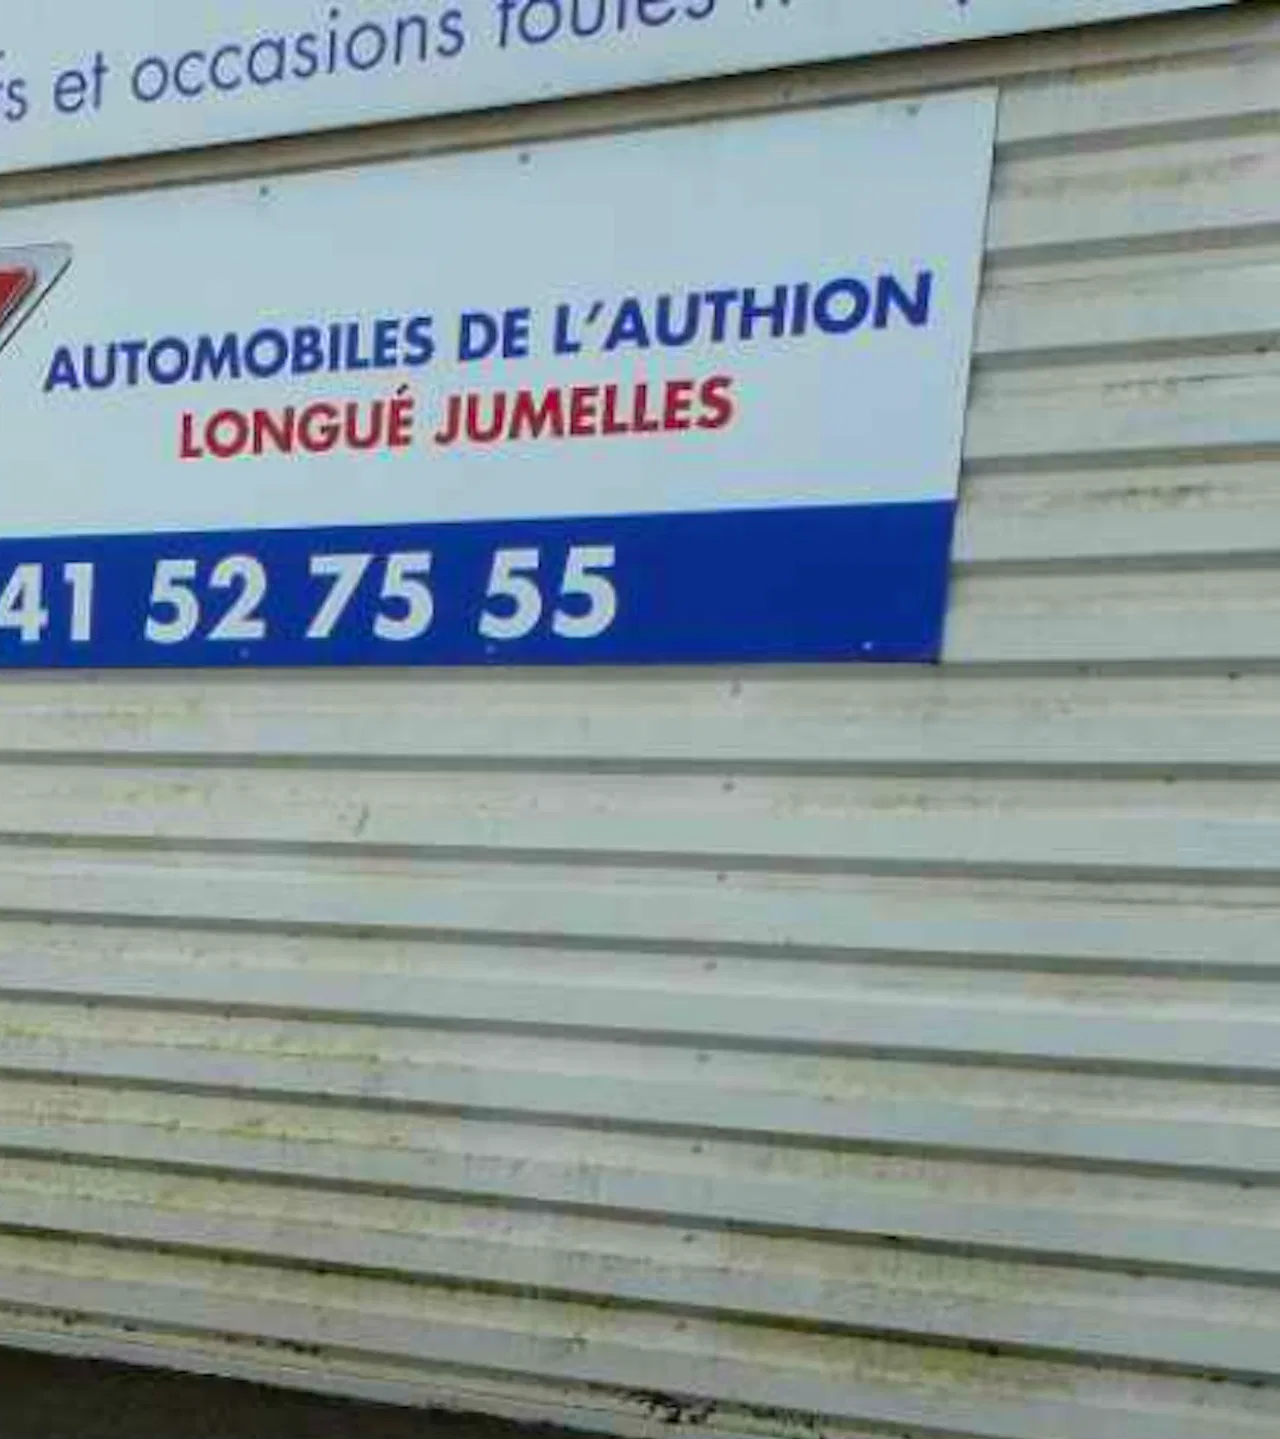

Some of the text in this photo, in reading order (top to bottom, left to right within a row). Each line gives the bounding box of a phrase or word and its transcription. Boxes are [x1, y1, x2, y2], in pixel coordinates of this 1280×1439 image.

[52, 51, 109, 113] et
[131, 8, 465, 103] occasions
[42, 270, 934, 392] AUTOMOBILES DE L'AUTHION
[178, 375, 735, 459] LONGUÉ JUMELLES
[144, 554, 269, 645] 52
[307, 550, 435, 642] 75
[477, 545, 619, 638] 55
